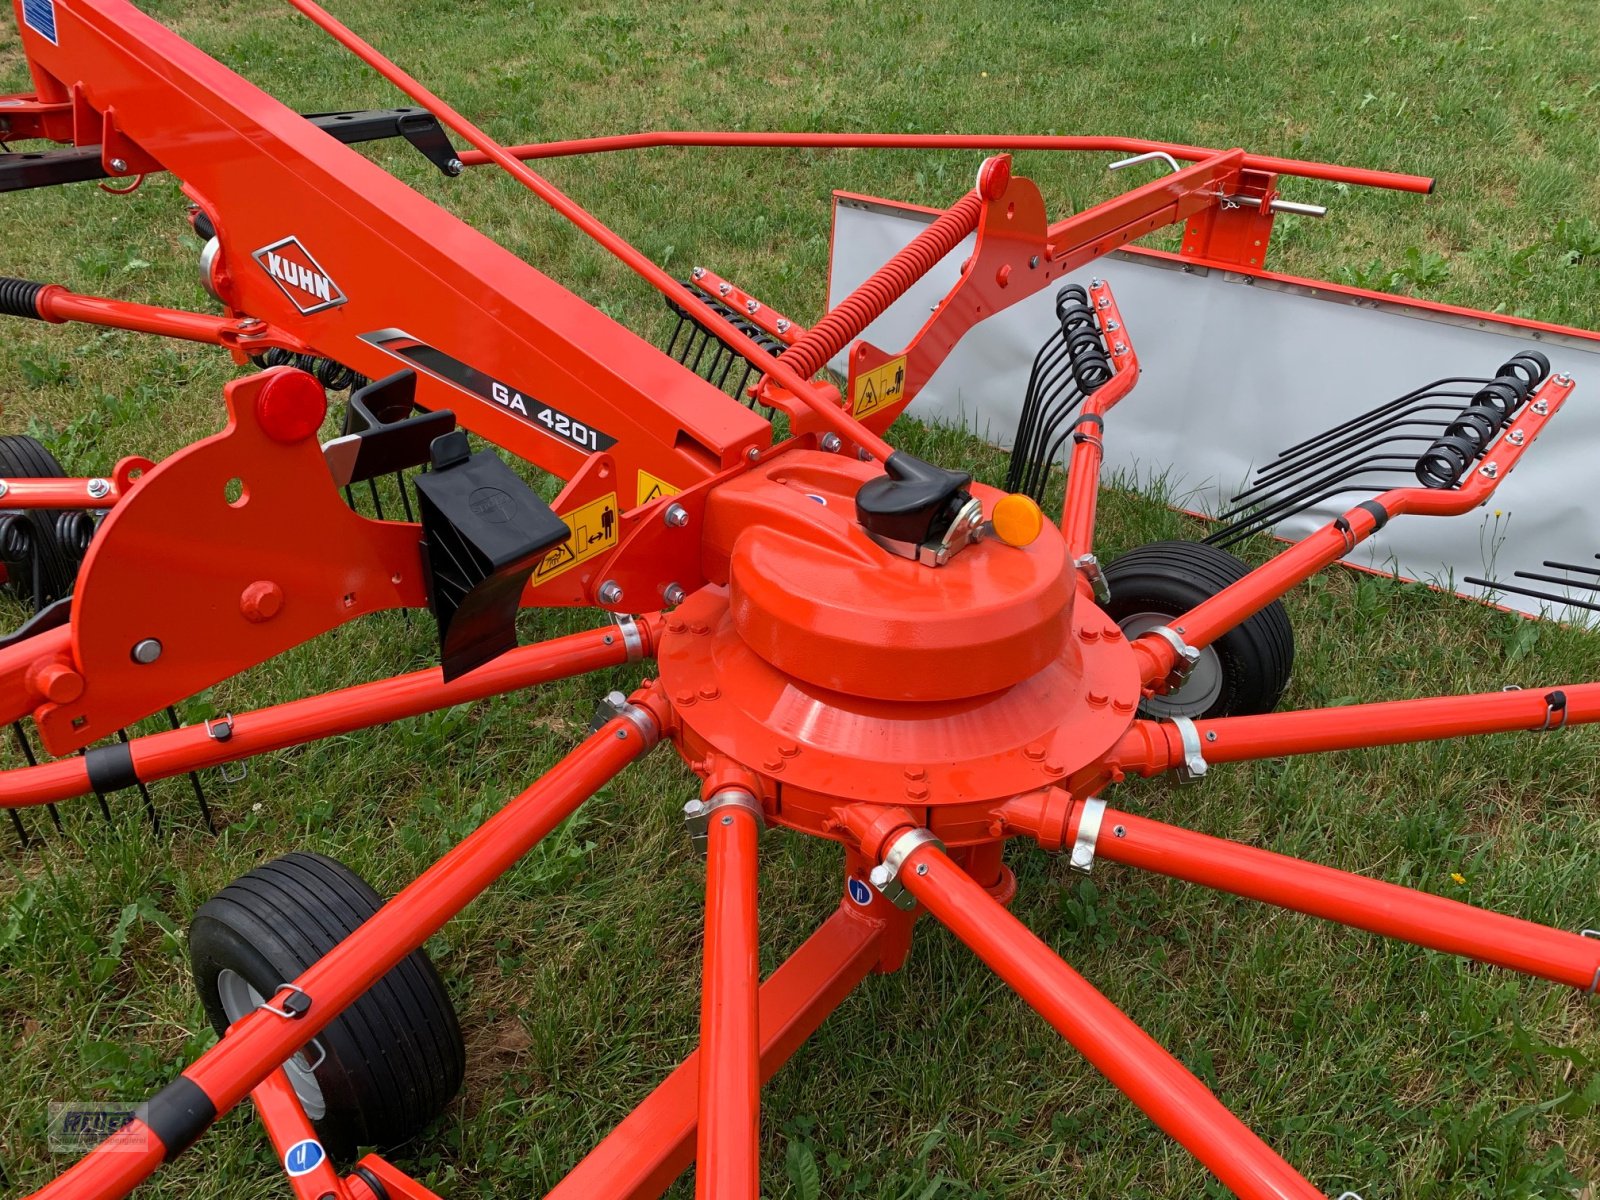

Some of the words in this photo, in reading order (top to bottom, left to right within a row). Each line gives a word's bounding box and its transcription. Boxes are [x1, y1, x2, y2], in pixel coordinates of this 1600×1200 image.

[267, 251, 331, 303] KUHN
[492, 382, 528, 416] GA
[537, 408, 597, 450] 4201
